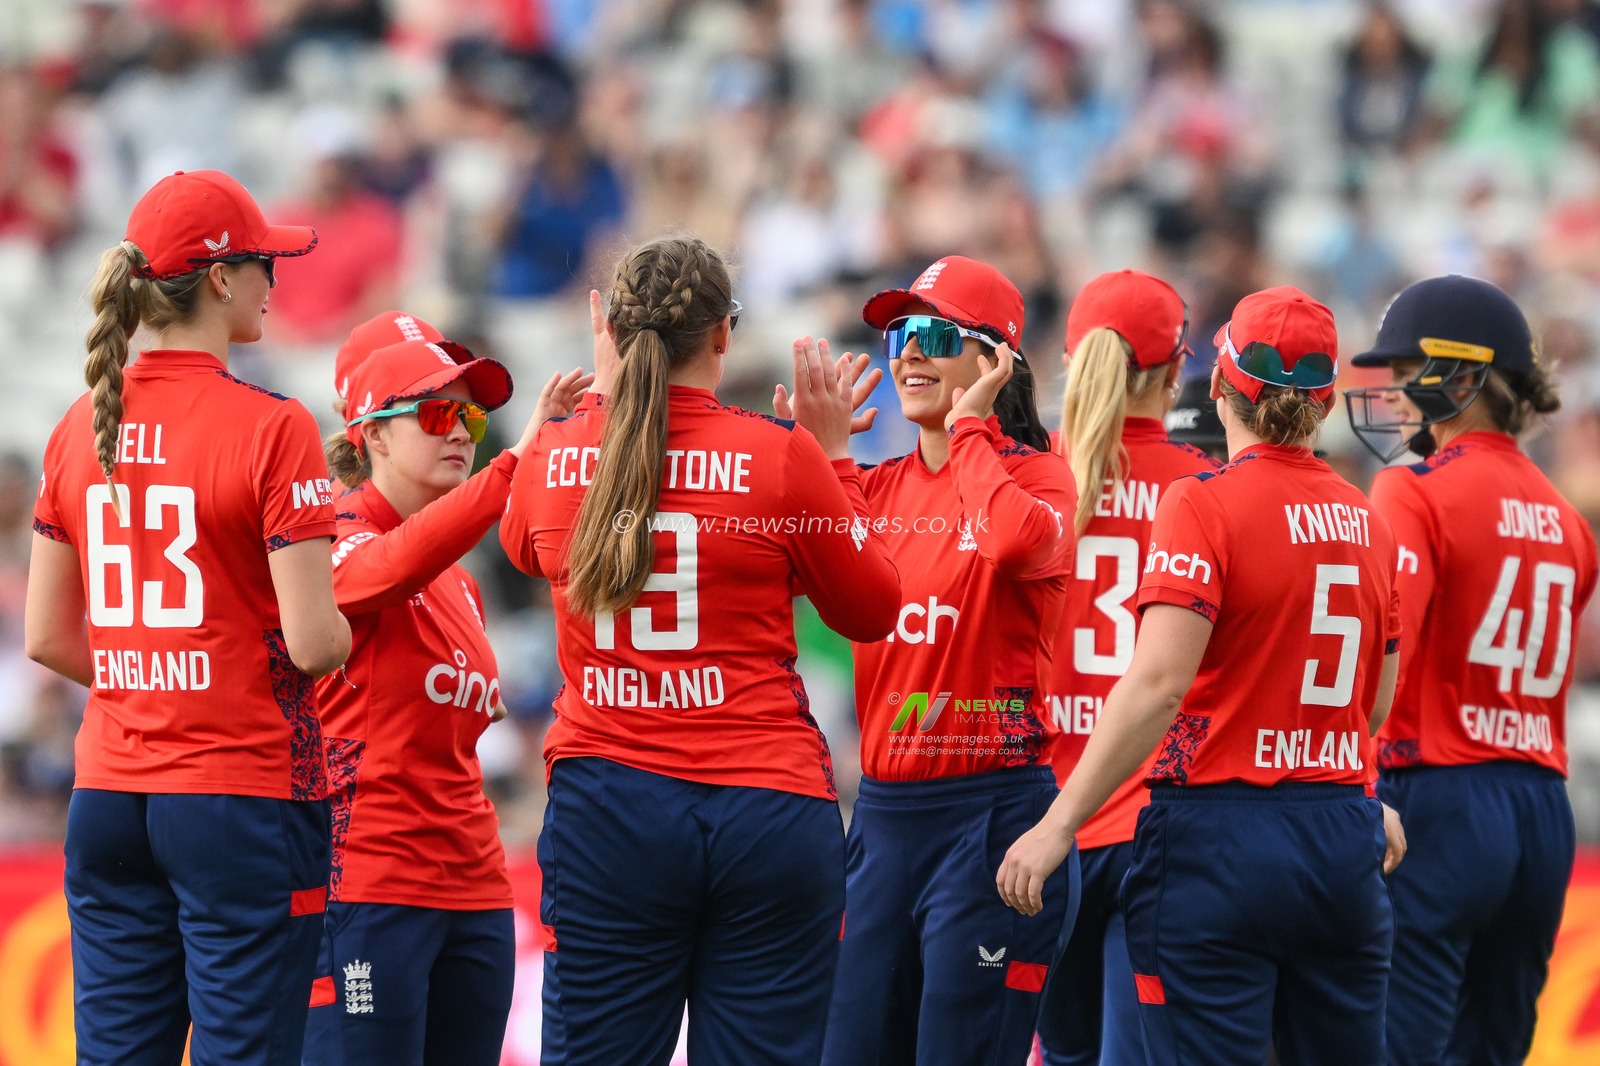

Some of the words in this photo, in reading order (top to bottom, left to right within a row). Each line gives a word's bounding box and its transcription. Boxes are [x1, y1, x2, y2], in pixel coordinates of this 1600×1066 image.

[546, 446, 752, 493] ECCTONE
[292, 478, 333, 510] METR
[1094, 478, 1160, 522] ENN
[1284, 503, 1370, 547] KNIGHT
[1497, 498, 1564, 545] JONES
[86, 484, 203, 628] 63
[1143, 542, 1212, 584] inch
[1073, 535, 1140, 676] 3
[1467, 556, 1576, 699] 40
[1300, 564, 1361, 707] 5
[93, 649, 210, 691] ENGLAND
[425, 649, 499, 718] cinc
[583, 665, 725, 710] ENGLAND
[1255, 728, 1364, 771] ENLAN
